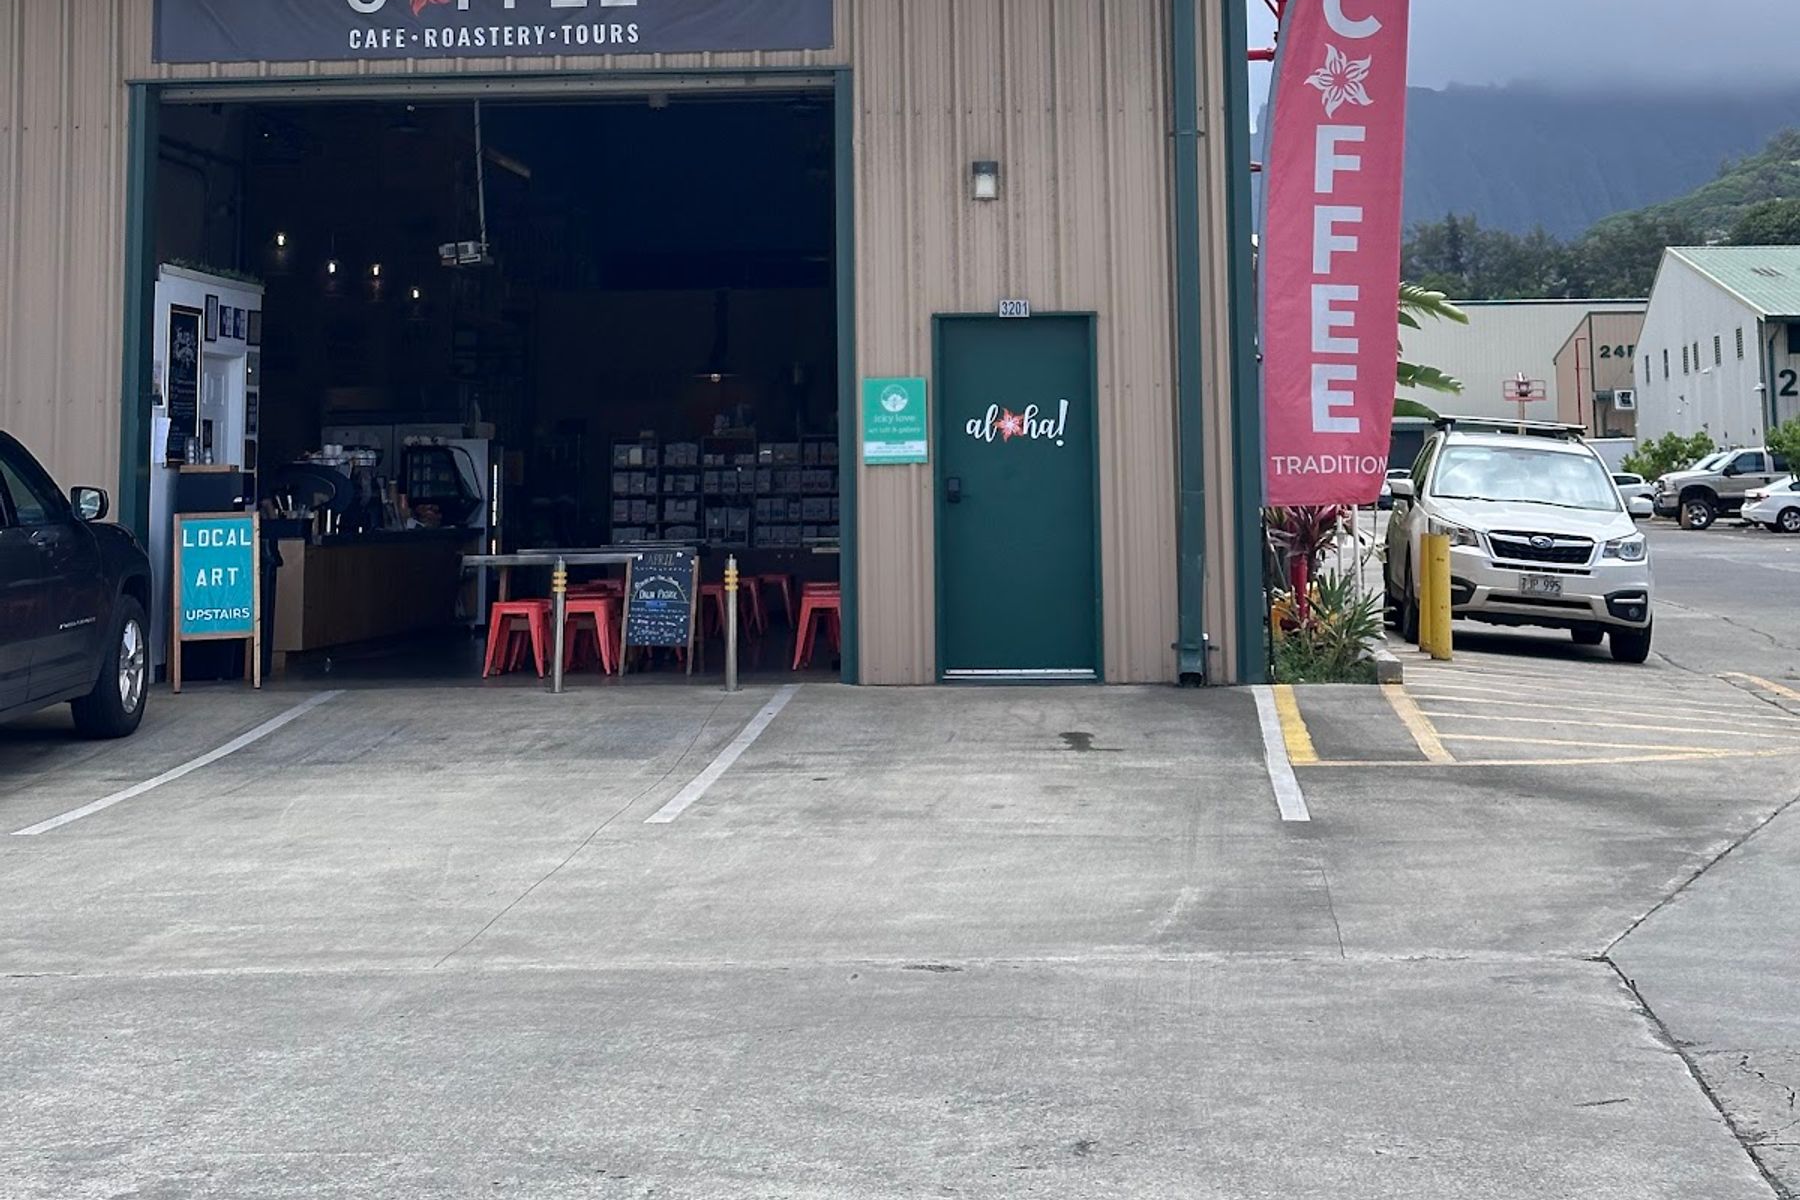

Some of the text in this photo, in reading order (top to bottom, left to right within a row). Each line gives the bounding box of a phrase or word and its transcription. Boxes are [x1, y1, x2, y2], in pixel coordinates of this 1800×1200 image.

[350, 23, 639, 49] CAFE ROASTERY TOURS
[1001, 301, 1028, 316] 3201
[1779, 369, 1798, 396] 2
[1271, 455, 1388, 475] TRADITION
[183, 528, 251, 547] LOCAL
[196, 567, 238, 586] ART
[186, 608, 250, 620] UPSTAIRS
